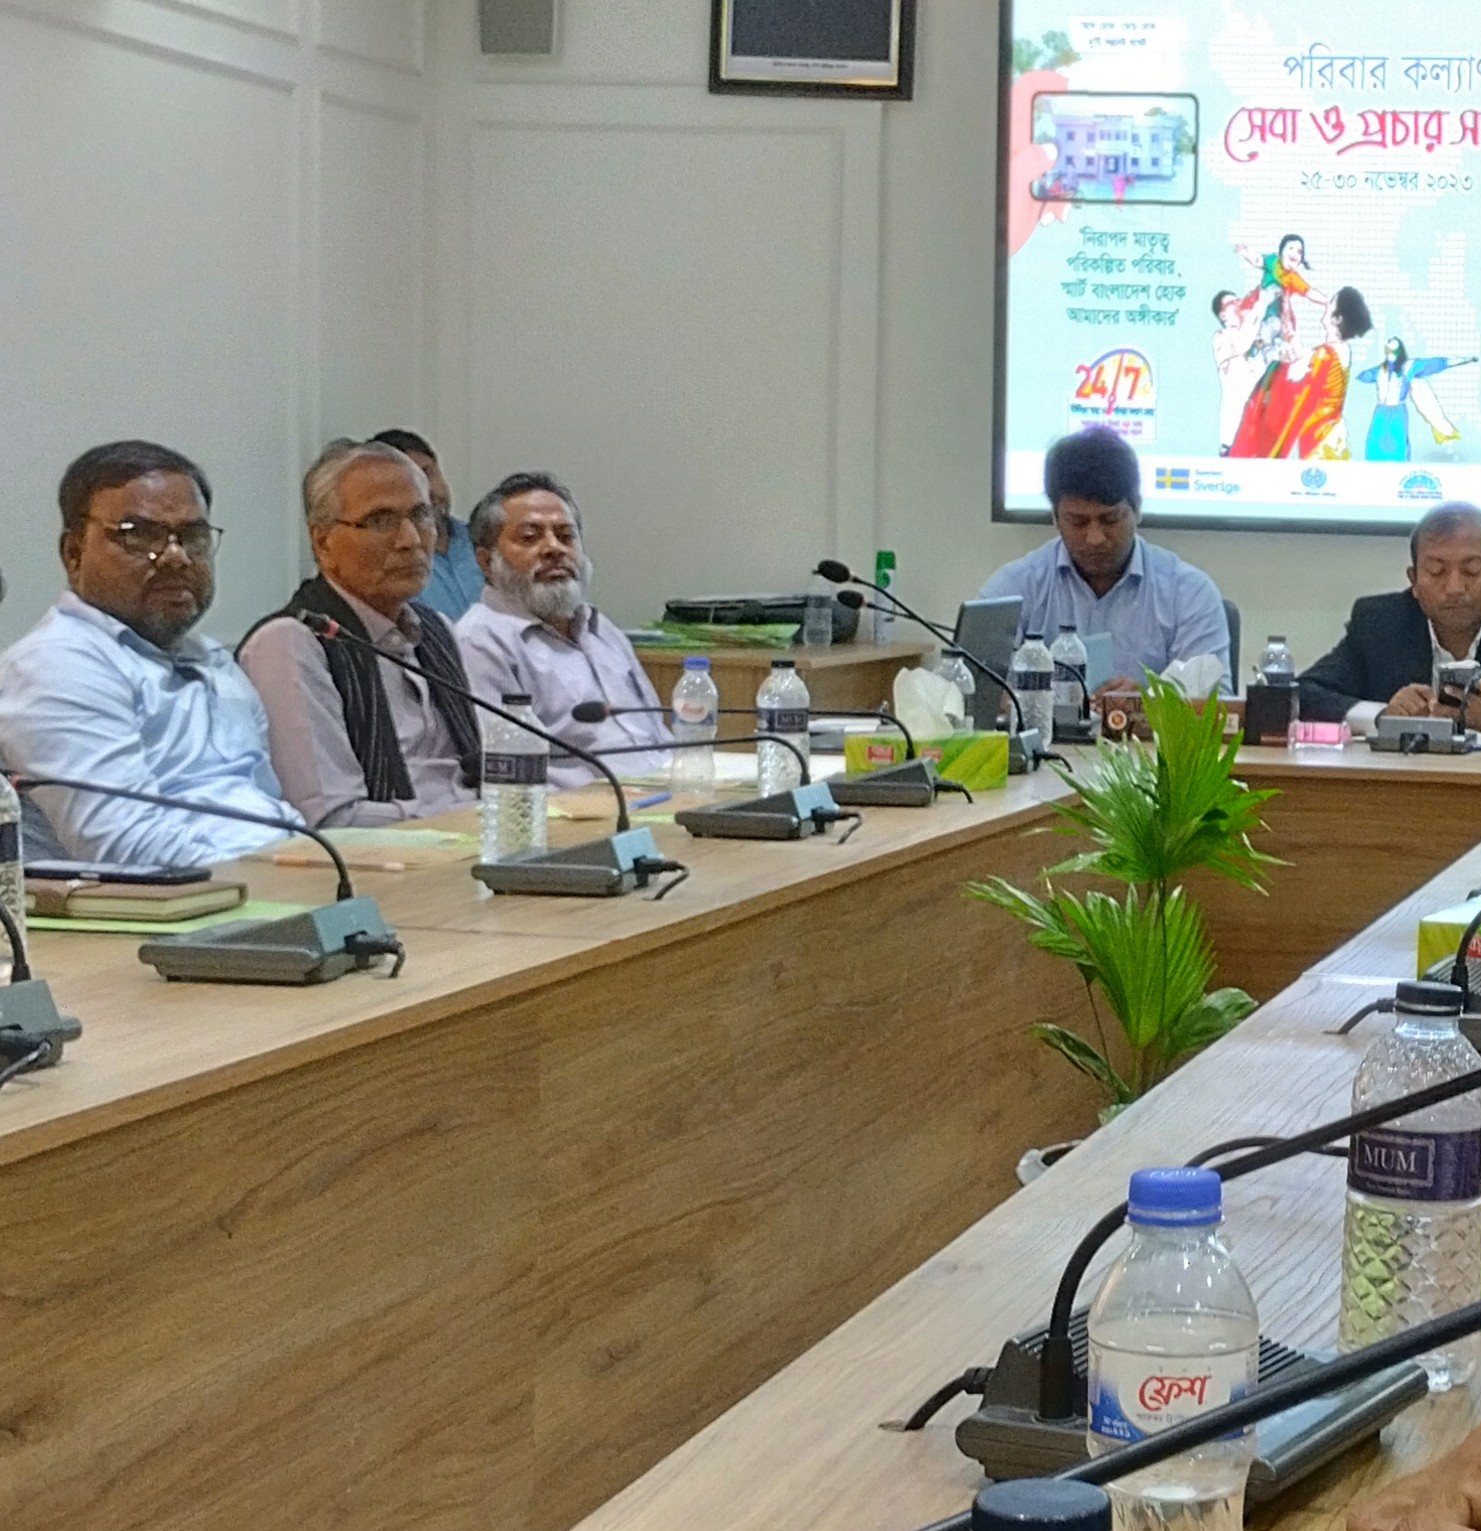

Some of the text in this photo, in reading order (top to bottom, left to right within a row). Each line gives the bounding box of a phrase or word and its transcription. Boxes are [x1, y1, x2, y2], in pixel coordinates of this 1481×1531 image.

[1283, 42, 1389, 90] পরিবার
[1223, 106, 1302, 163] সেবা
[1309, 105, 1345, 144] ও
[1336, 108, 1450, 156] প্রচার
[1301, 171, 1474, 192] ২৫-৩০ নভেম্বর ২০২৩
[1132, 231, 1172, 254] মাতৃত্ব
[1090, 283, 1151, 301] বাংলাদেশ
[1155, 285, 1187, 302] হোক
[1065, 307, 1121, 325] আমাদের
[1363, 1143, 1417, 1174] MUM
[1138, 1374, 1212, 1412] ফ্রেশ
